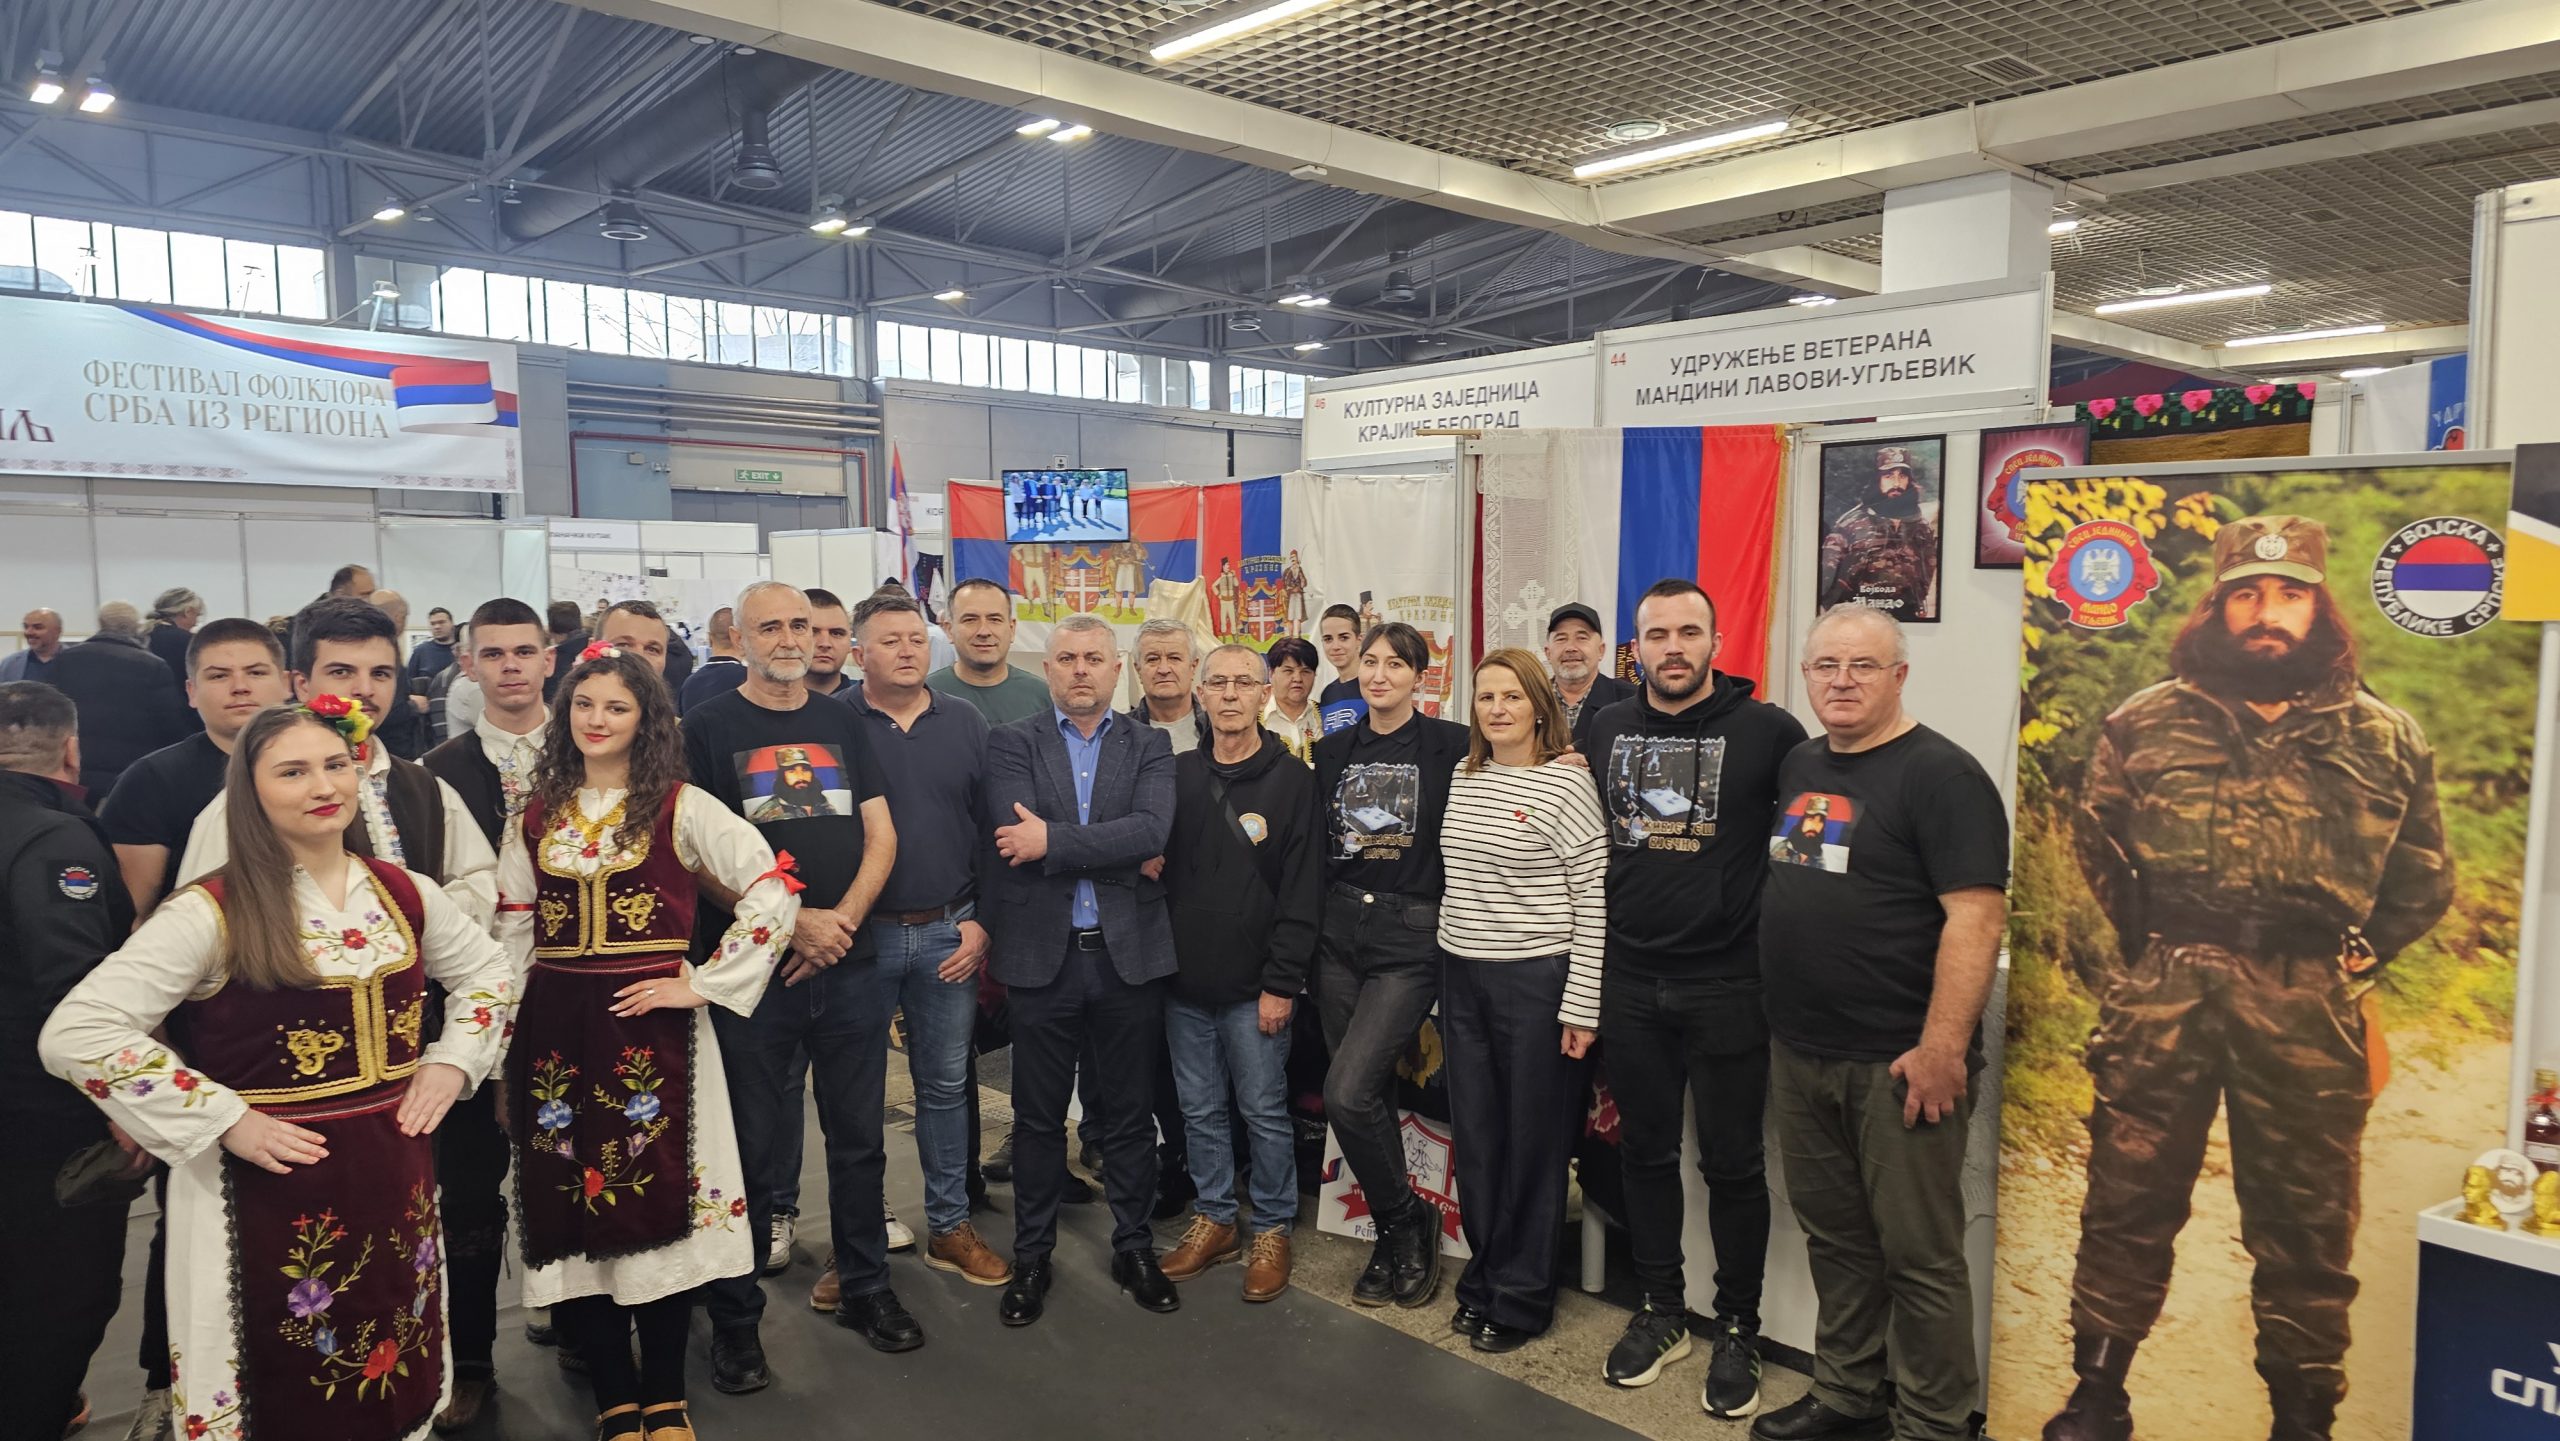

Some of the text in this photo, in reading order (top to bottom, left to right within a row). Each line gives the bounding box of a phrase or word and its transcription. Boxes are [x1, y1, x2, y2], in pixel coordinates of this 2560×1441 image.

[1610, 353, 1627, 366] 44
[1670, 327, 1932, 377] УДРУЖЕЊЕ ВЕТЕРАНА
[83, 359, 387, 406] ФЕСТИВАЛ ФОЛКЛОРА
[1344, 380, 1539, 419] КУЛТУРНА ЗАЈЕДНИЦА
[1635, 353, 1976, 406] МАНДИНИ ЛАВОВИ-УГЉЕВИК
[84, 392, 390, 439] СРБА ИЗ РЕГИОНА
[1314, 398, 1326, 409] 46
[751, 471, 769, 480] EXIT
[2400, 520, 2488, 546] ВОЈСКА
[2374, 557, 2454, 635] РЕПУБЛИКЕ
